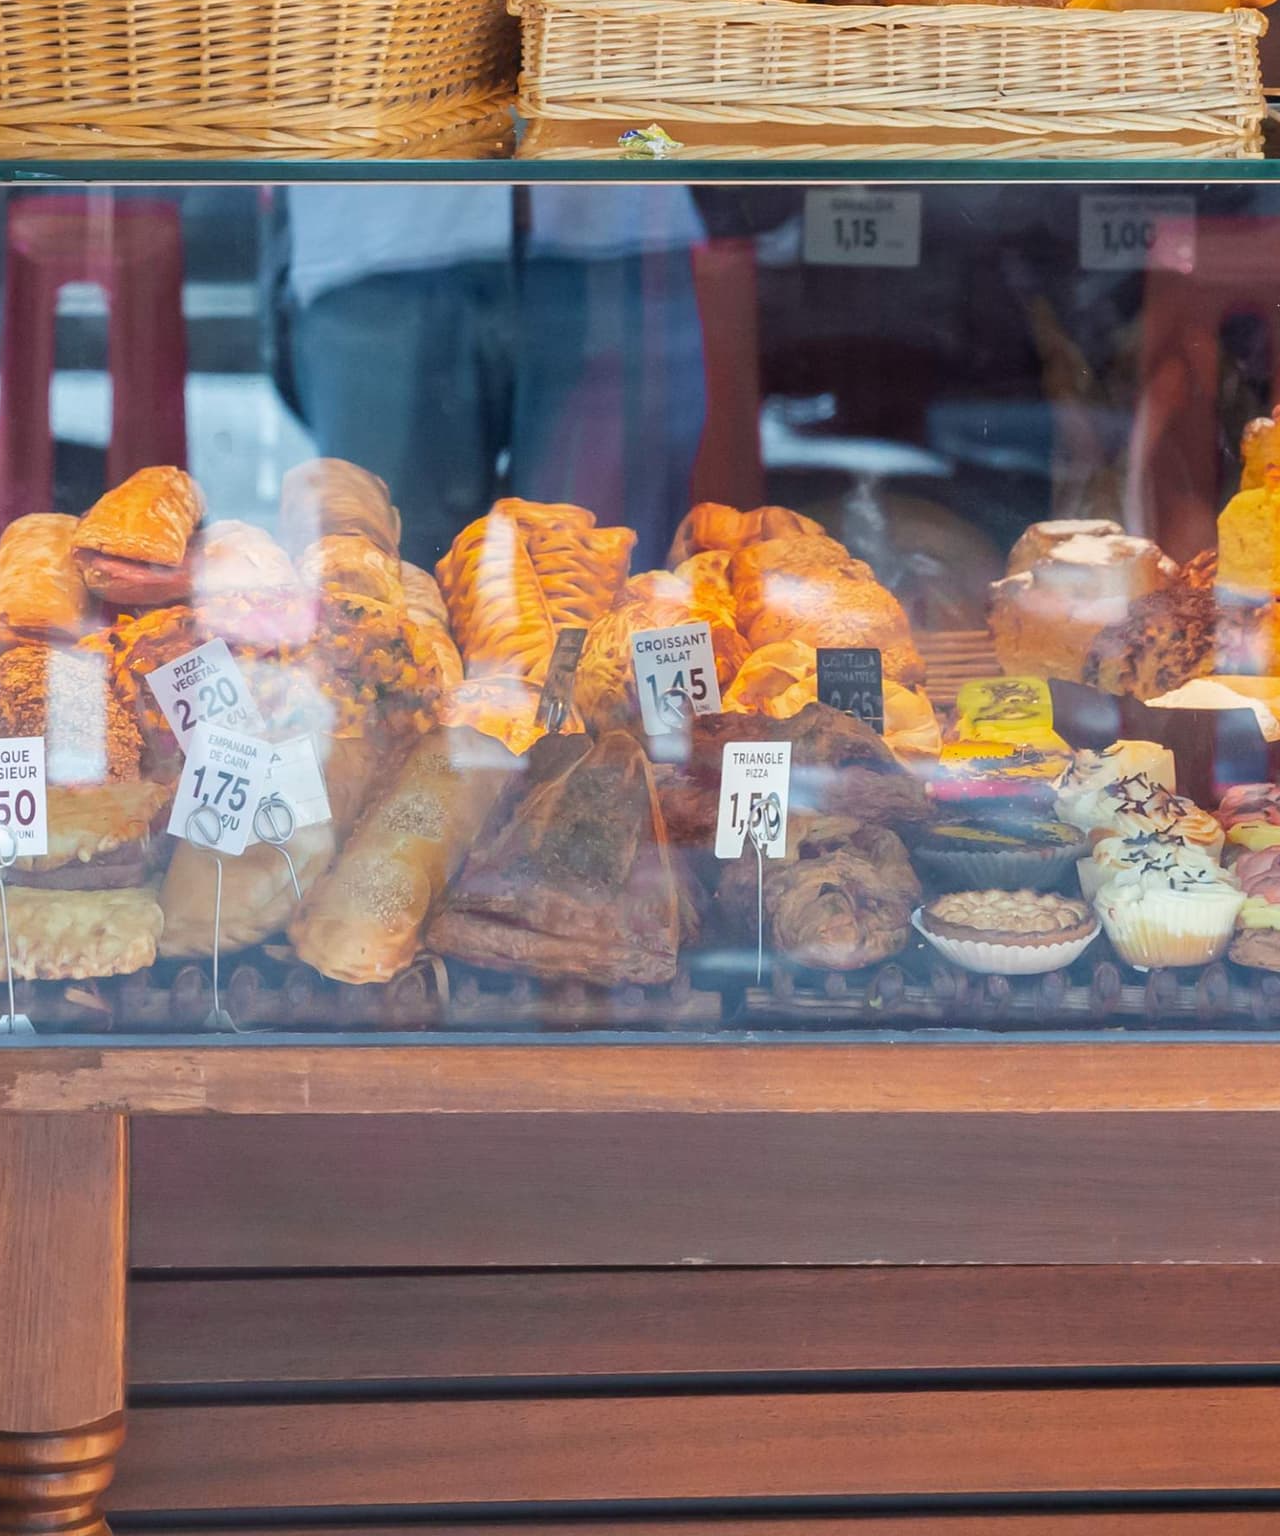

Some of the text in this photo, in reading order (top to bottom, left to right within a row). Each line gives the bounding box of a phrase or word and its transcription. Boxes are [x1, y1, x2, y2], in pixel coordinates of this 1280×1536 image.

[834, 218, 877, 252] 1,15
[636, 632, 707, 653] CROISSANT
[173, 656, 206, 678] PIZZA
[656, 650, 691, 664] SALAT
[172, 663, 221, 693] VEGETAL
[208, 734, 258, 758] EMPANADA
[209, 749, 223, 761] DE
[223, 753, 250, 770] CARN
[733, 752, 784, 764] TRIANGLE
[746, 768, 768, 778] PIZZA
[192, 766, 250, 812] 1,75
